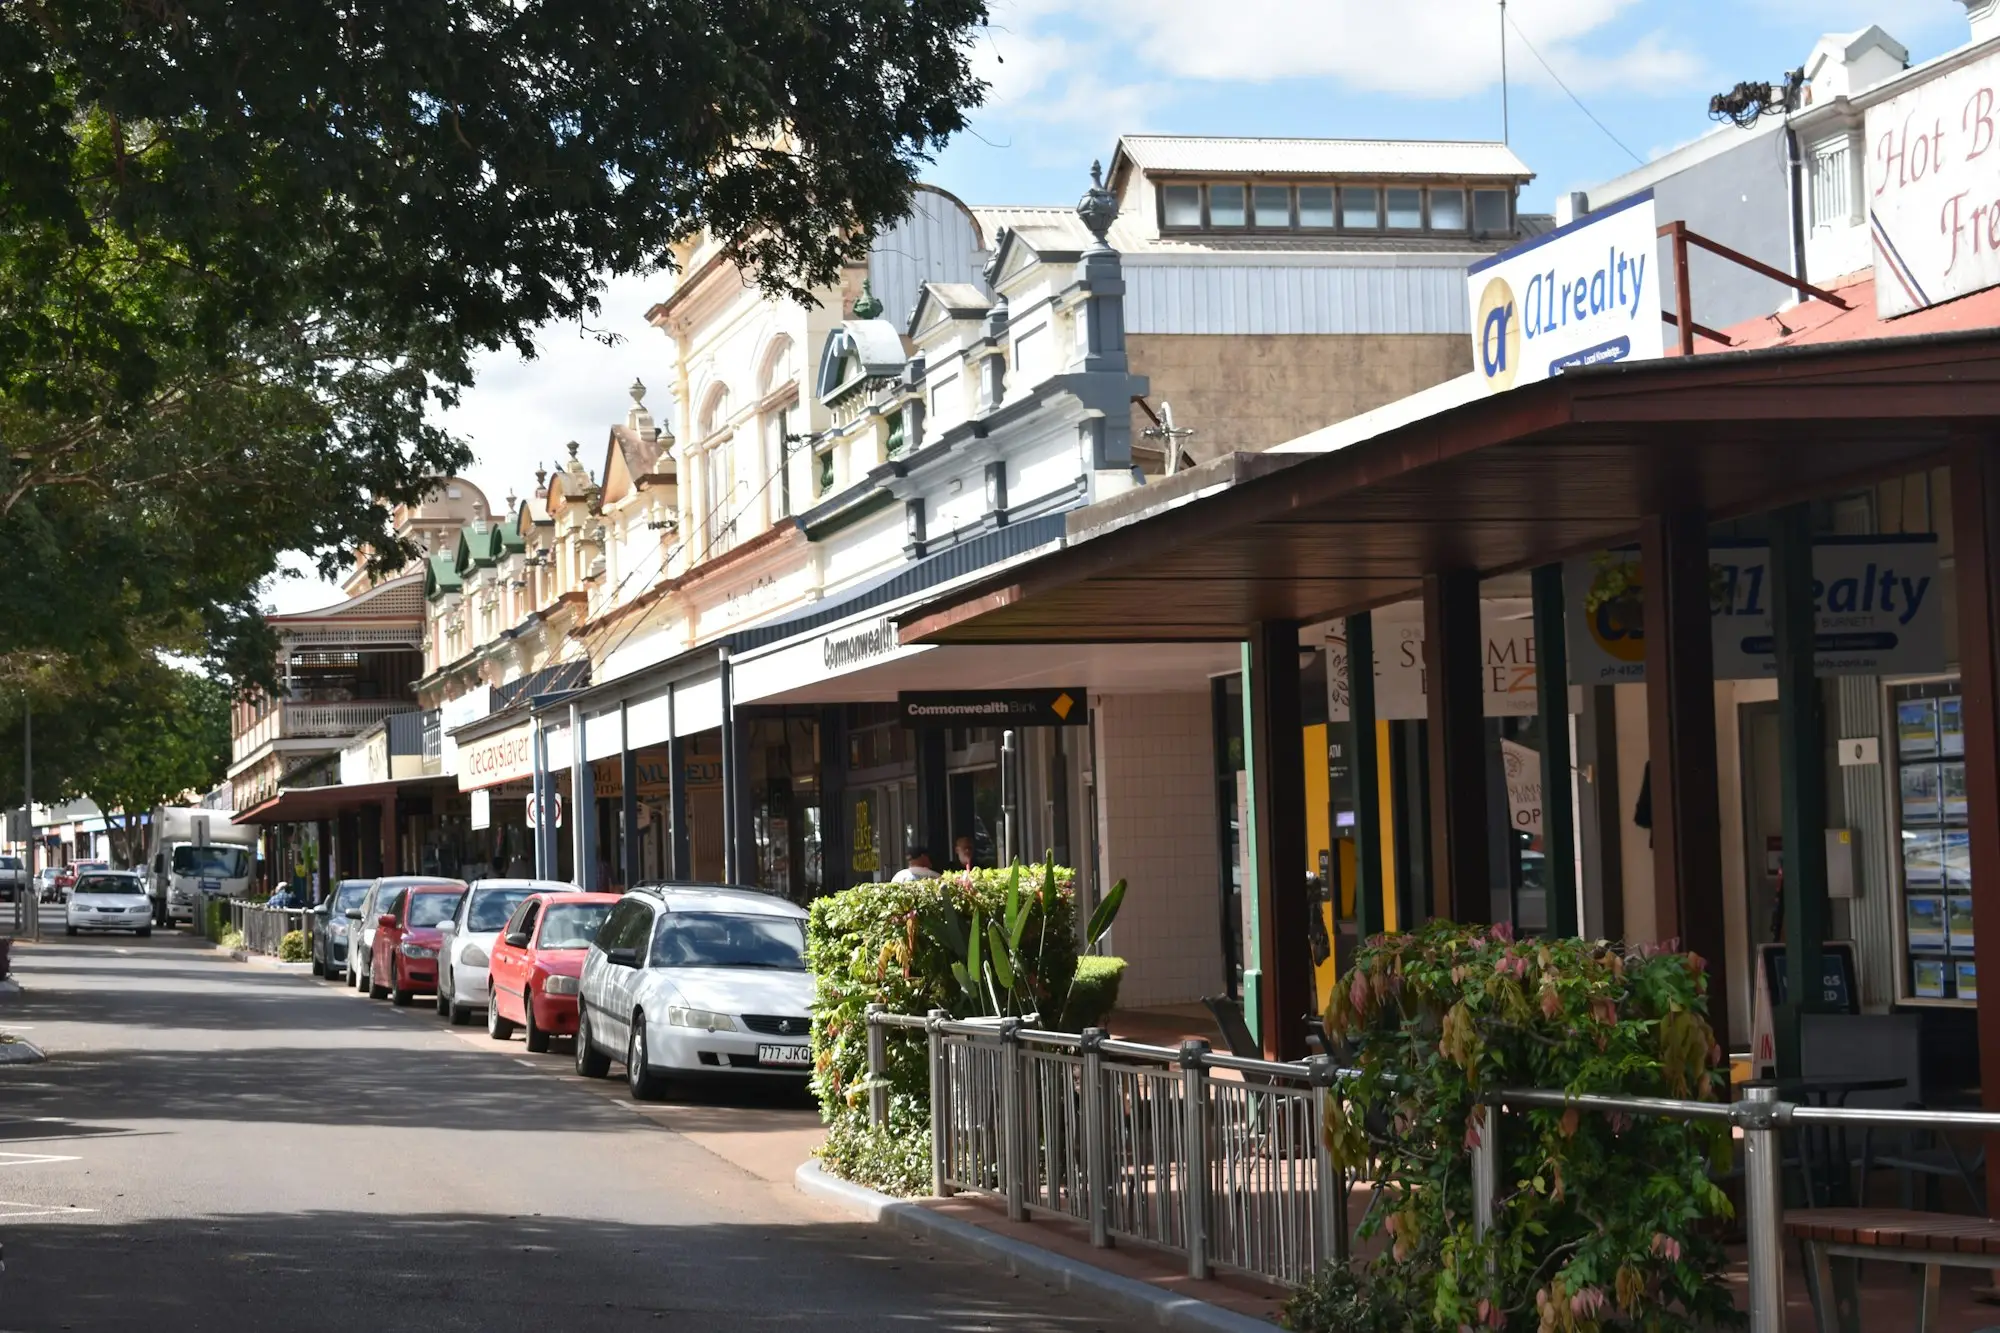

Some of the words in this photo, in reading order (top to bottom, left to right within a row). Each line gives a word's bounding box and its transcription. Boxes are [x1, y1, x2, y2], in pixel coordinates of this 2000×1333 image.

[1875, 108, 1945, 197] Hot
[1962, 87, 2000, 162] B
[1821, 616, 1876, 628] BURNETT
[823, 617, 893, 670] Commonwealth
[908, 701, 1009, 716] Commonwealth
[1010, 702, 1038, 714] Bank
[469, 735, 530, 780] decayslayer
[1328, 743, 1342, 759] ATM
